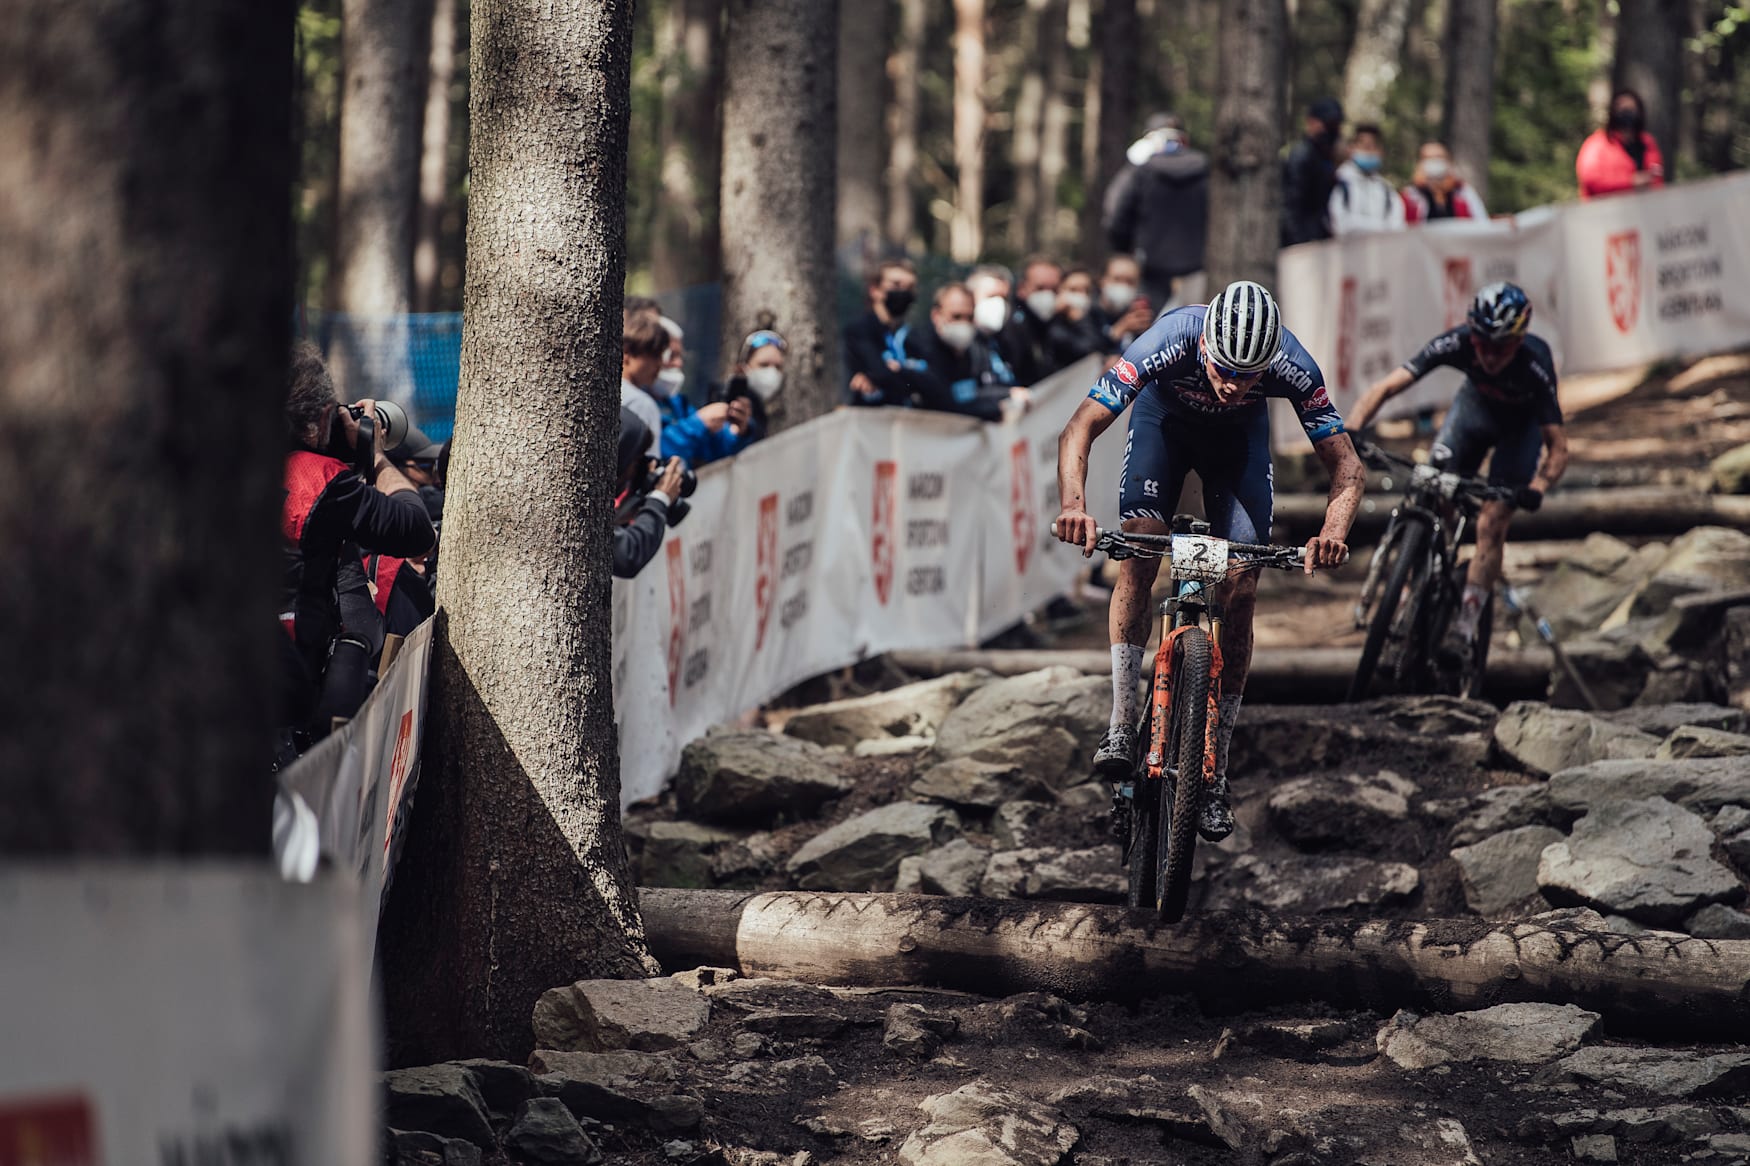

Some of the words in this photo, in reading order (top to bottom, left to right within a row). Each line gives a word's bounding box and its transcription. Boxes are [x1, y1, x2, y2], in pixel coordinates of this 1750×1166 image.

[1142, 341, 1186, 376] FENIX
[1270, 350, 1313, 392] Alpecin
[1193, 543, 1209, 562] 2
